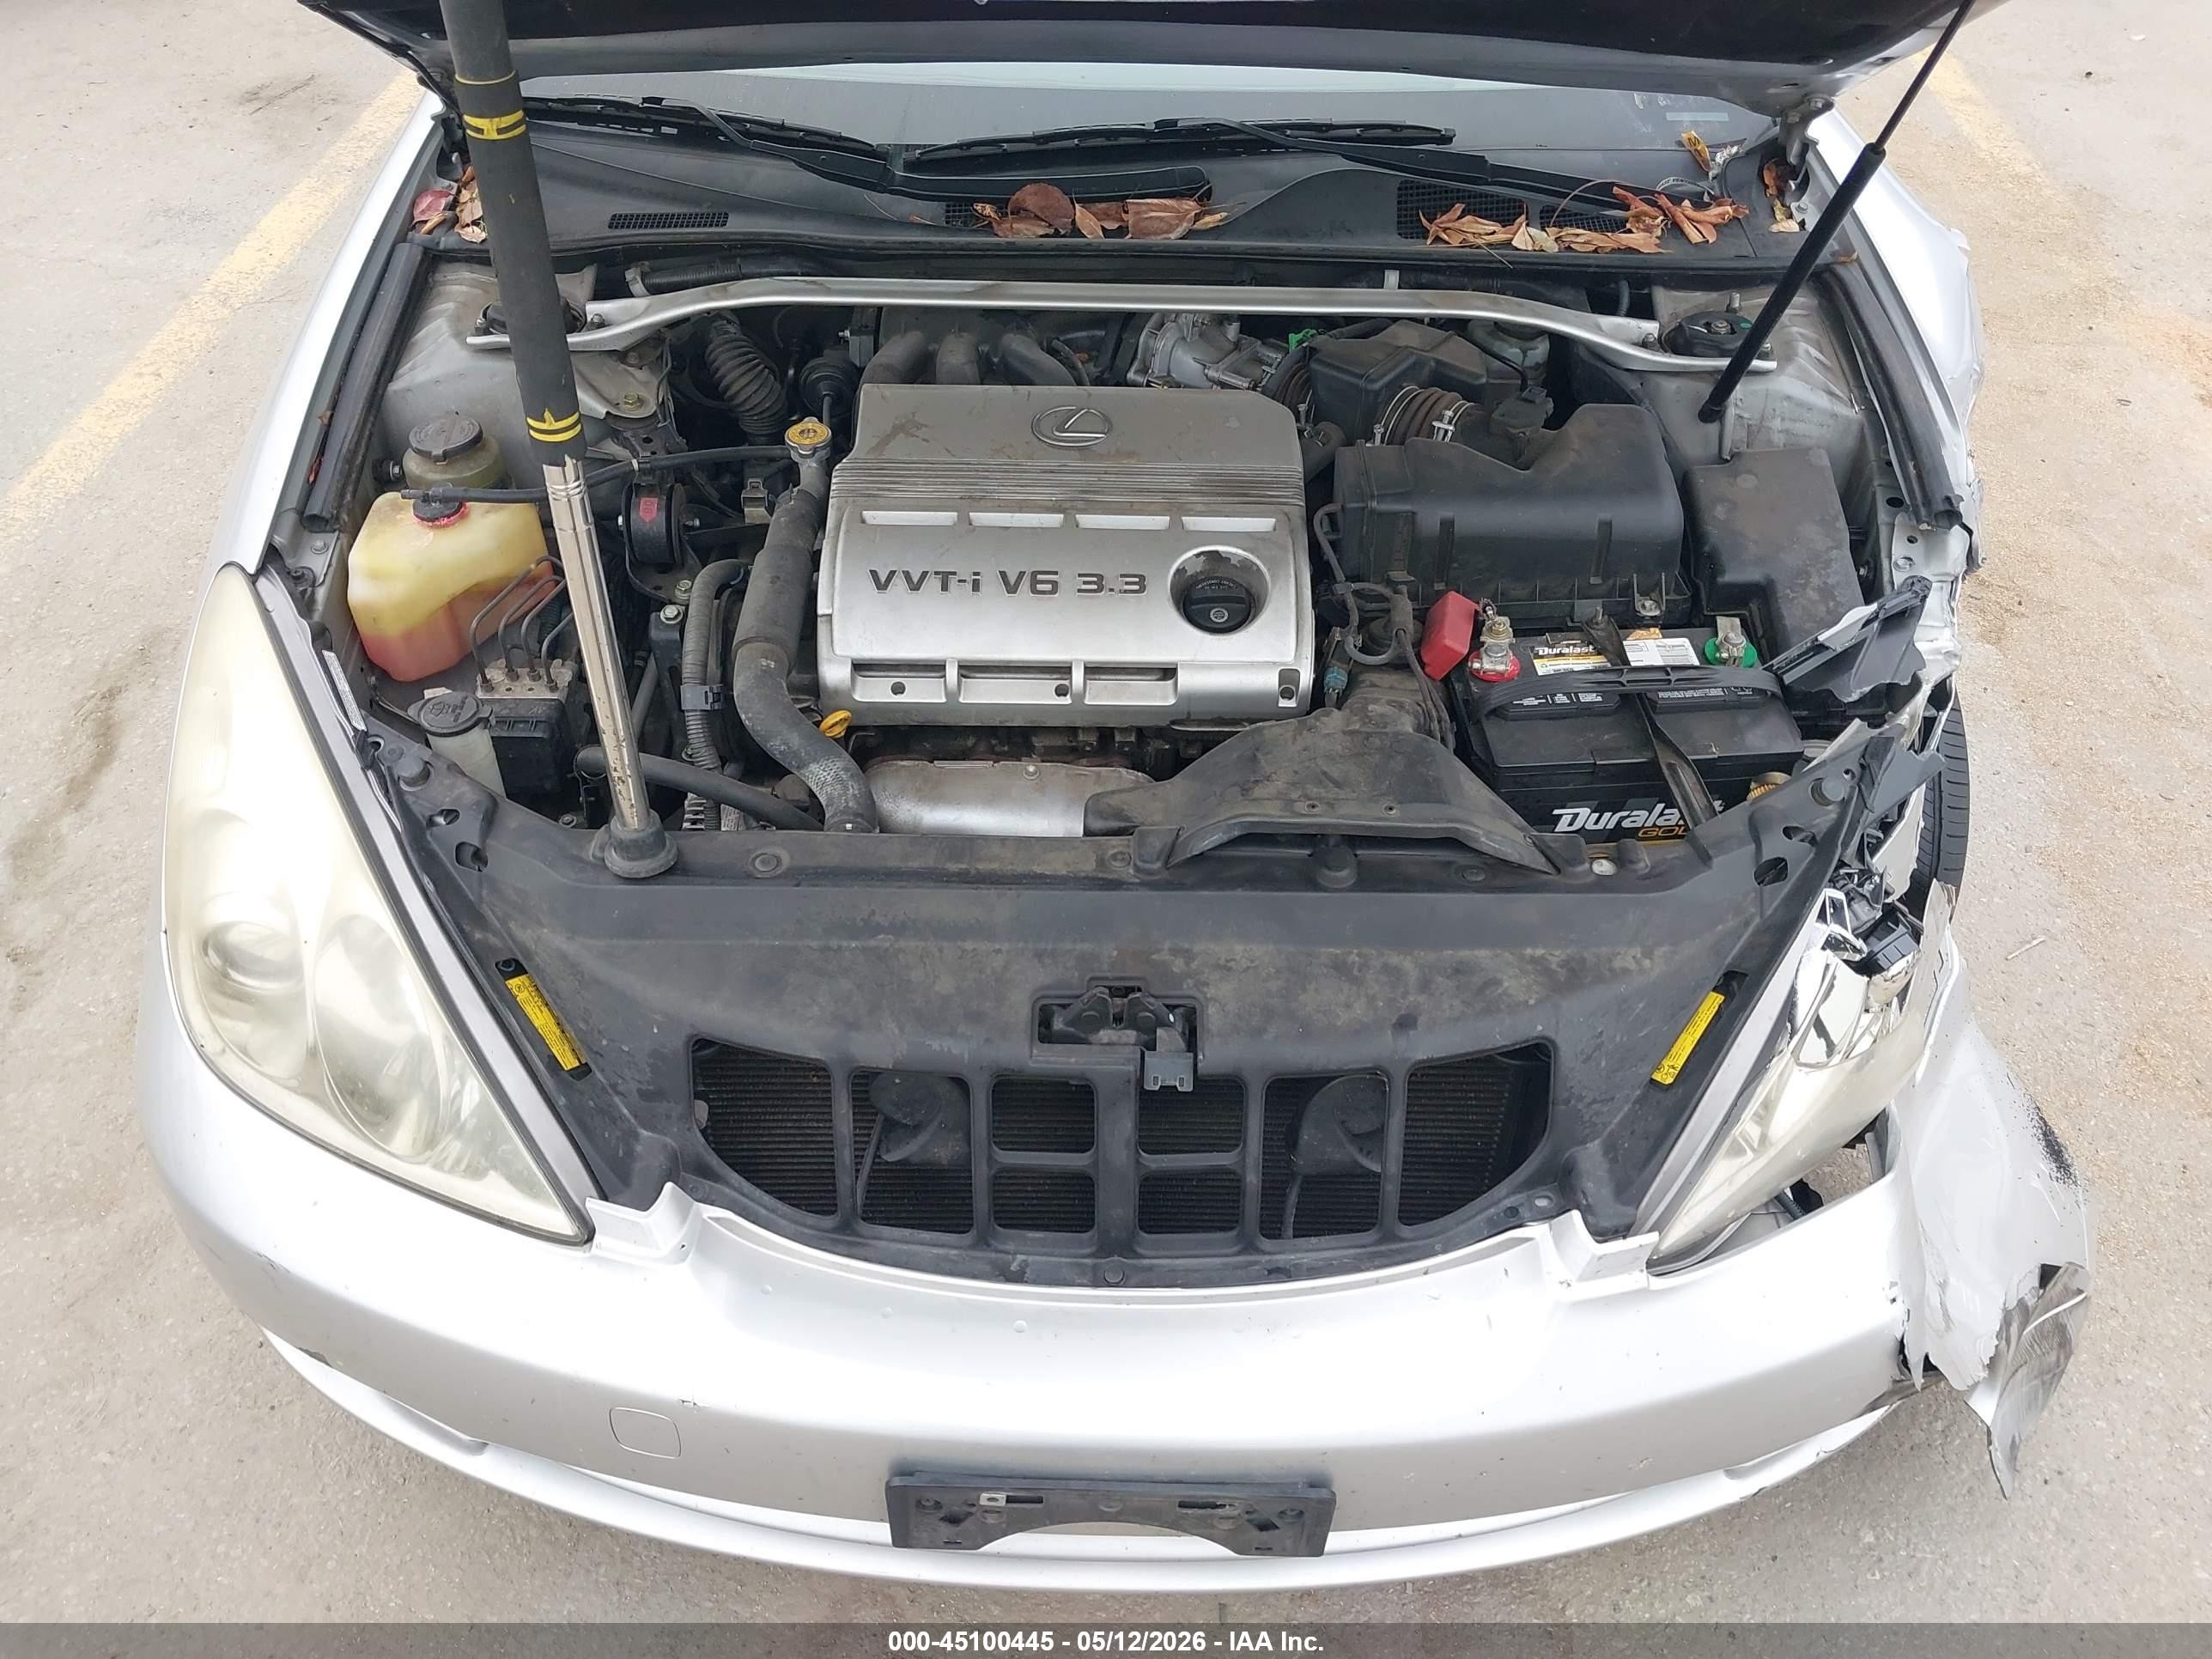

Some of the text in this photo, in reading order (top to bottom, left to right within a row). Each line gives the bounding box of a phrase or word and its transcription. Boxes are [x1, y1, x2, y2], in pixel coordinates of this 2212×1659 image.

[867, 569, 1147, 596] VVT-i V6 3.3
[1534, 645, 1595, 656] Duralast
[1638, 825, 1687, 838] GOL
